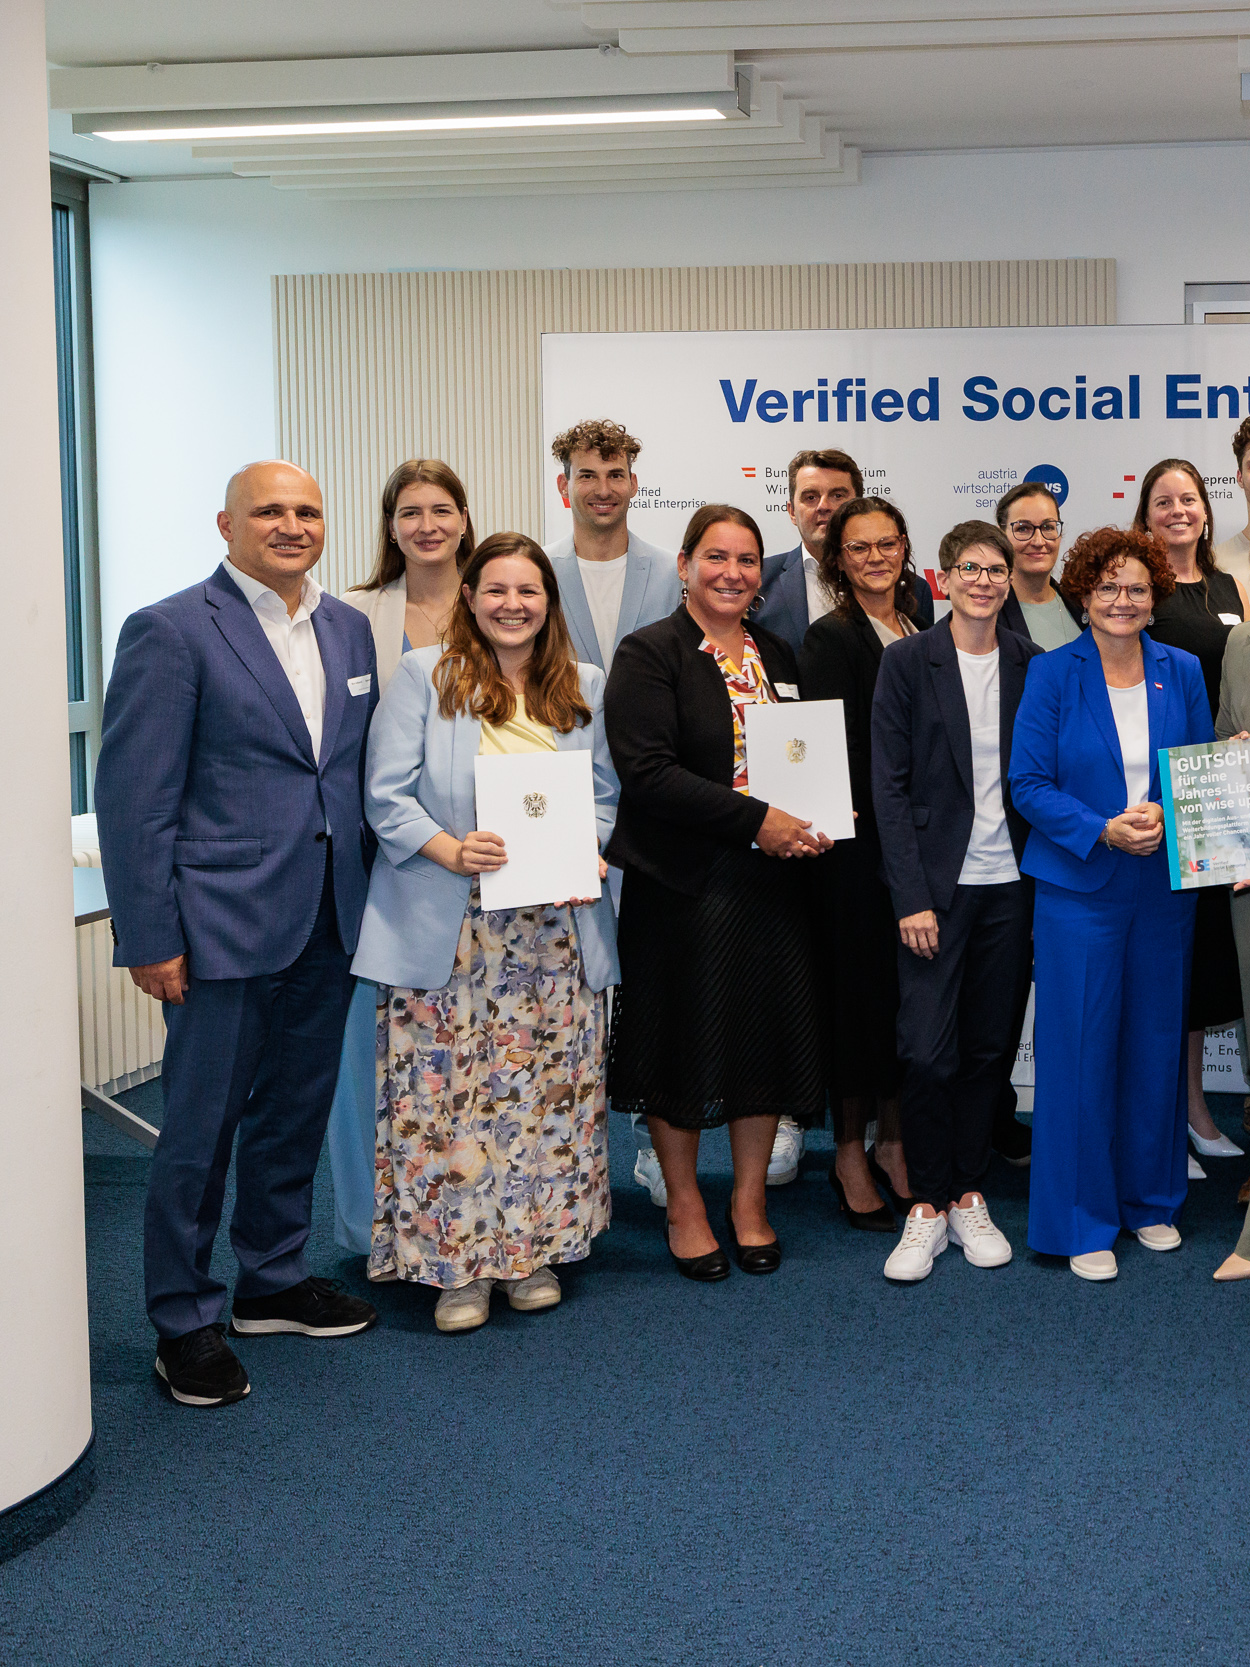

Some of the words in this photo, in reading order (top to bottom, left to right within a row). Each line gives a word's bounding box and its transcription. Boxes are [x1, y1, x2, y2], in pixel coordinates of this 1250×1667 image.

[719, 376, 940, 423] Verified
[961, 374, 1141, 422] Social
[977, 468, 1018, 479] austria
[1202, 476, 1236, 487] epren
[637, 486, 661, 497] ified
[1208, 489, 1233, 499] stria
[628, 498, 651, 509] ocial
[654, 498, 707, 511] Enterprise
[1178, 774, 1197, 787] für
[1200, 772, 1227, 784] eine
[1180, 803, 1203, 814] von
[1205, 798, 1235, 811] wise
[1188, 859, 1210, 873] VSE
[1202, 1064, 1232, 1073] smus
